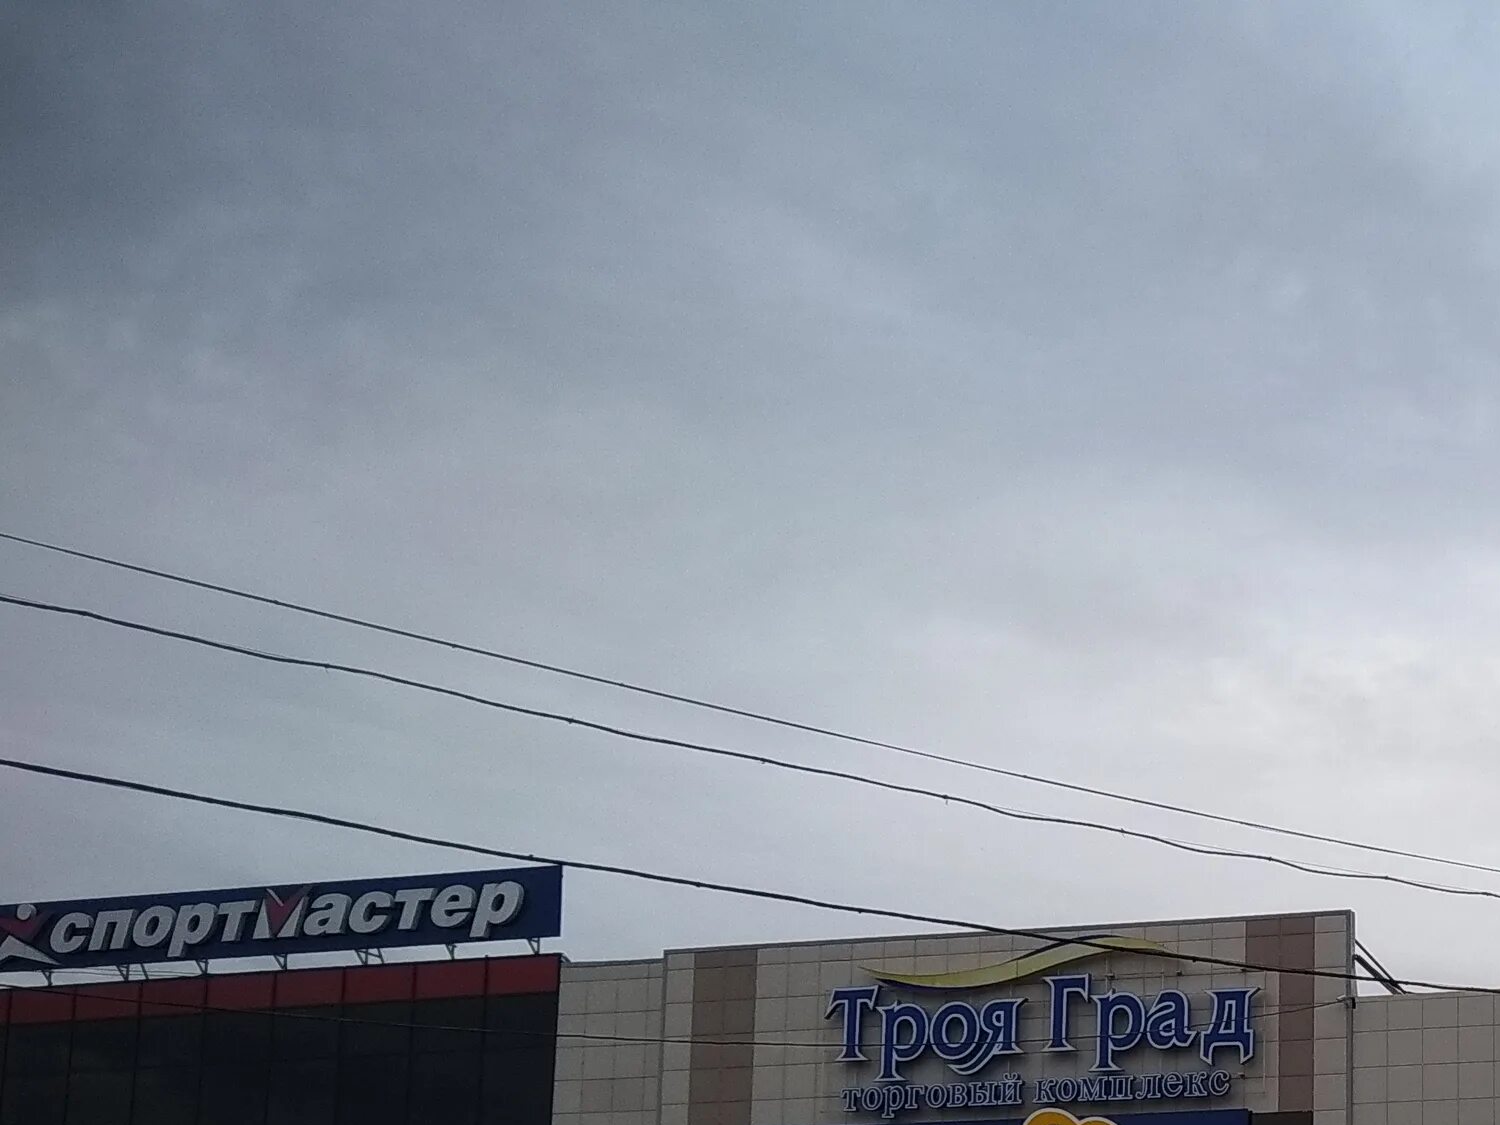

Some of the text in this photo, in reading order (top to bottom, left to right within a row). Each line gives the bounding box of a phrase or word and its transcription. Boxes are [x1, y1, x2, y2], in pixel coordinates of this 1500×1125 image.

[824, 972, 1262, 1083] Троя Град
[841, 1068, 1232, 1119] торговый комплекс
